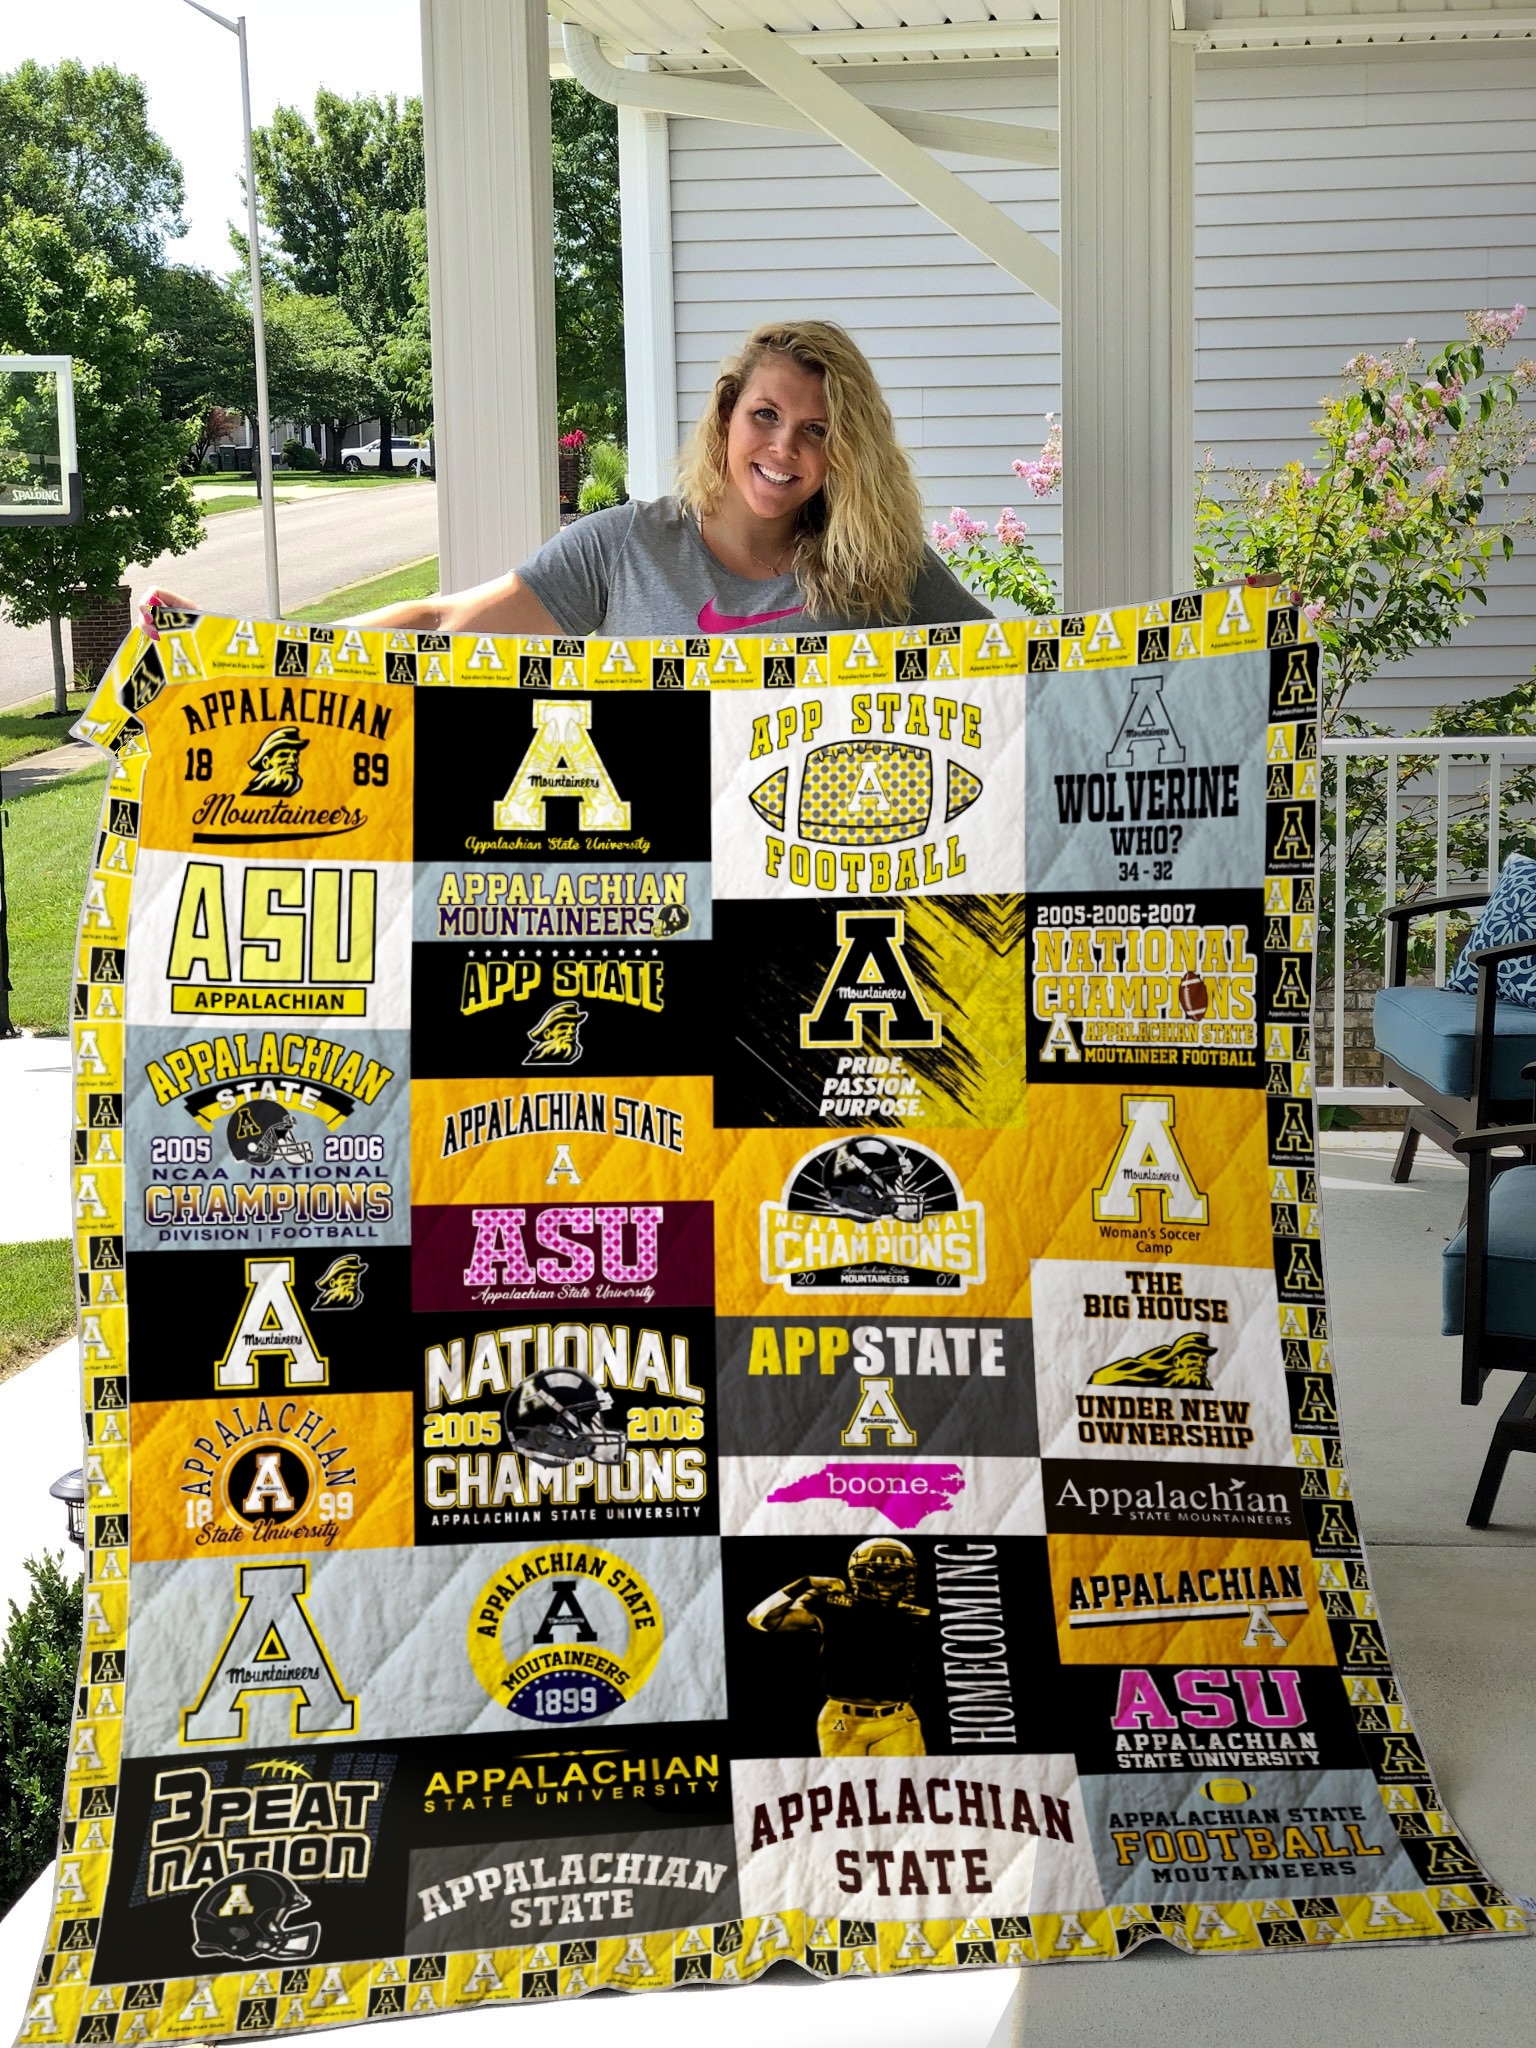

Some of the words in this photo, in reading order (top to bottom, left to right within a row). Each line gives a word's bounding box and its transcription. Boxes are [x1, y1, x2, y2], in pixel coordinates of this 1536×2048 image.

[12, 490, 60, 501] SPALDING
[181, 687, 392, 740] APPALACHIAN
[750, 700, 822, 760] APP
[852, 693, 981, 749] STATE
[1106, 675, 1186, 768] A
[184, 748, 213, 781] 18
[353, 753, 389, 787] 89
[494, 700, 631, 830] A
[528, 775, 599, 789] Mountaineers
[847, 761, 892, 813] A
[1054, 765, 1240, 824] WOLVERINE
[192, 793, 368, 826] Mountaineers
[465, 837, 542, 854] Appalachian
[548, 837, 579, 851] State
[586, 837, 650, 853] University
[1110, 825, 1183, 856] WHO?
[766, 835, 966, 893] FOOTBALL
[438, 872, 687, 906] APPALACHIAN
[166, 861, 377, 983] ASU
[438, 906, 655, 937] MOUNTAINEERS
[1037, 904, 1196, 925] 2005-2006-2007
[1032, 925, 1257, 974] NATIONAL
[461, 962, 541, 1015] APP
[553, 960, 664, 1013] STATE
[800, 910, 942, 1048] A
[837, 986, 906, 1000] Mountaineers
[194, 992, 344, 1009] APPALACHIAN
[1033, 975, 1257, 1021] CHAMPINS
[1040, 1012, 1081, 1062] A
[1083, 1021, 1200, 1043] APPALACHIAN
[1202, 1022, 1255, 1045] STATE
[145, 1032, 394, 1106] APPALACHIAN
[837, 1056, 907, 1074] PRIDE.
[1084, 1048, 1178, 1064] MOUTAINEER
[1182, 1049, 1256, 1066] FOOTBALL
[216, 1080, 322, 1111] STATE
[823, 1078, 922, 1095] PASSION.
[237, 1108, 261, 1139] A
[819, 1098, 925, 1116] PURPOSE.
[441, 1092, 608, 1159] APPALACHIAN
[613, 1095, 684, 1154] STATE
[151, 1137, 212, 1164] 2005
[324, 1135, 384, 1162] 2006
[545, 1144, 581, 1185] A
[1092, 1093, 1209, 1226] A
[152, 1168, 229, 1180] NCAA
[250, 1166, 389, 1179] NATIONAL
[1121, 1168, 1179, 1182] Mountaineers
[145, 1182, 393, 1225] CHAMPIONS
[159, 1228, 248, 1241] DIVISION
[271, 1226, 378, 1239] FOOTBALL
[775, 1213, 840, 1233] NCAA
[854, 1212, 972, 1235] NATIONAL
[1100, 1225, 1156, 1240] Woman's
[1160, 1227, 1201, 1242] Soccer
[464, 1206, 663, 1285] ASU
[775, 1231, 972, 1270] CHAMPIONS
[1136, 1241, 1172, 1255] Camp
[472, 1285, 555, 1304] Appalachian
[557, 1284, 591, 1299] State
[596, 1285, 656, 1303] University
[796, 1272, 816, 1285] 20
[840, 1274, 909, 1284] MOUNTAINEERS
[1125, 1271, 1183, 1295] THE
[214, 1257, 329, 1390] A
[1083, 1294, 1130, 1319] BIG
[1137, 1296, 1229, 1324] HOUSE
[242, 1333, 302, 1346] Mountaineers
[425, 1322, 705, 1412] NATIONAL
[627, 1406, 704, 1441] 2006
[841, 1376, 917, 1446] A
[1076, 1395, 1175, 1421] UNDER
[1181, 1399, 1250, 1424] NEW
[423, 1411, 500, 1447] 2005
[1078, 1421, 1255, 1449] OWNERSHIP
[181, 1401, 356, 1498] APPALACHIAN
[242, 1452, 294, 1512] A
[424, 1448, 707, 1510] CHAMPIONS
[827, 1473, 937, 1495] boone.
[185, 1498, 213, 1528] 18
[319, 1492, 354, 1520] 99
[1055, 1478, 1290, 1516] Appalachian
[196, 1521, 244, 1546] State
[252, 1518, 340, 1547] University
[431, 1511, 541, 1526] APPALACHIAN
[550, 1509, 597, 1521] STATE
[607, 1506, 701, 1520] UNIVERSITY
[1129, 1511, 1171, 1521] STATE
[1178, 1513, 1292, 1525] MOUNTAINEERS
[477, 1552, 608, 1638] APPALACHIAN
[607, 1569, 656, 1630] STATE
[1069, 1565, 1304, 1611] APPALACHIAN
[533, 1581, 598, 1644] A
[1242, 1604, 1288, 1648] A
[179, 1559, 359, 1747] A
[934, 1543, 1017, 1745] HOMECOMING
[225, 1665, 319, 1684] Mountaineers
[501, 1650, 631, 1692] MOUTAINEERS
[535, 1687, 597, 1716] 1899
[1110, 1669, 1308, 1730] ASU
[1116, 1732, 1318, 1752] APPALACHIAN
[424, 1754, 719, 1797] APPALACHIAN
[1117, 1753, 1184, 1769] STATE
[1191, 1751, 1320, 1768] UNIVERSITY
[424, 1794, 513, 1814] STATE
[536, 1780, 719, 1805] UNIVERSITY
[751, 1778, 1075, 1853] APPALACHIAN
[1109, 1808, 1281, 1829] APPALACHIAN
[1289, 1805, 1366, 1823] STATE
[1111, 1825, 1385, 1866] FOOTBALL
[417, 1852, 728, 1923] APPALACHIAN
[835, 1848, 993, 1896] STATE
[1153, 1861, 1357, 1884] MOUTAINEERS
[218, 1884, 254, 1917] A
[510, 1888, 634, 1929] STATE
